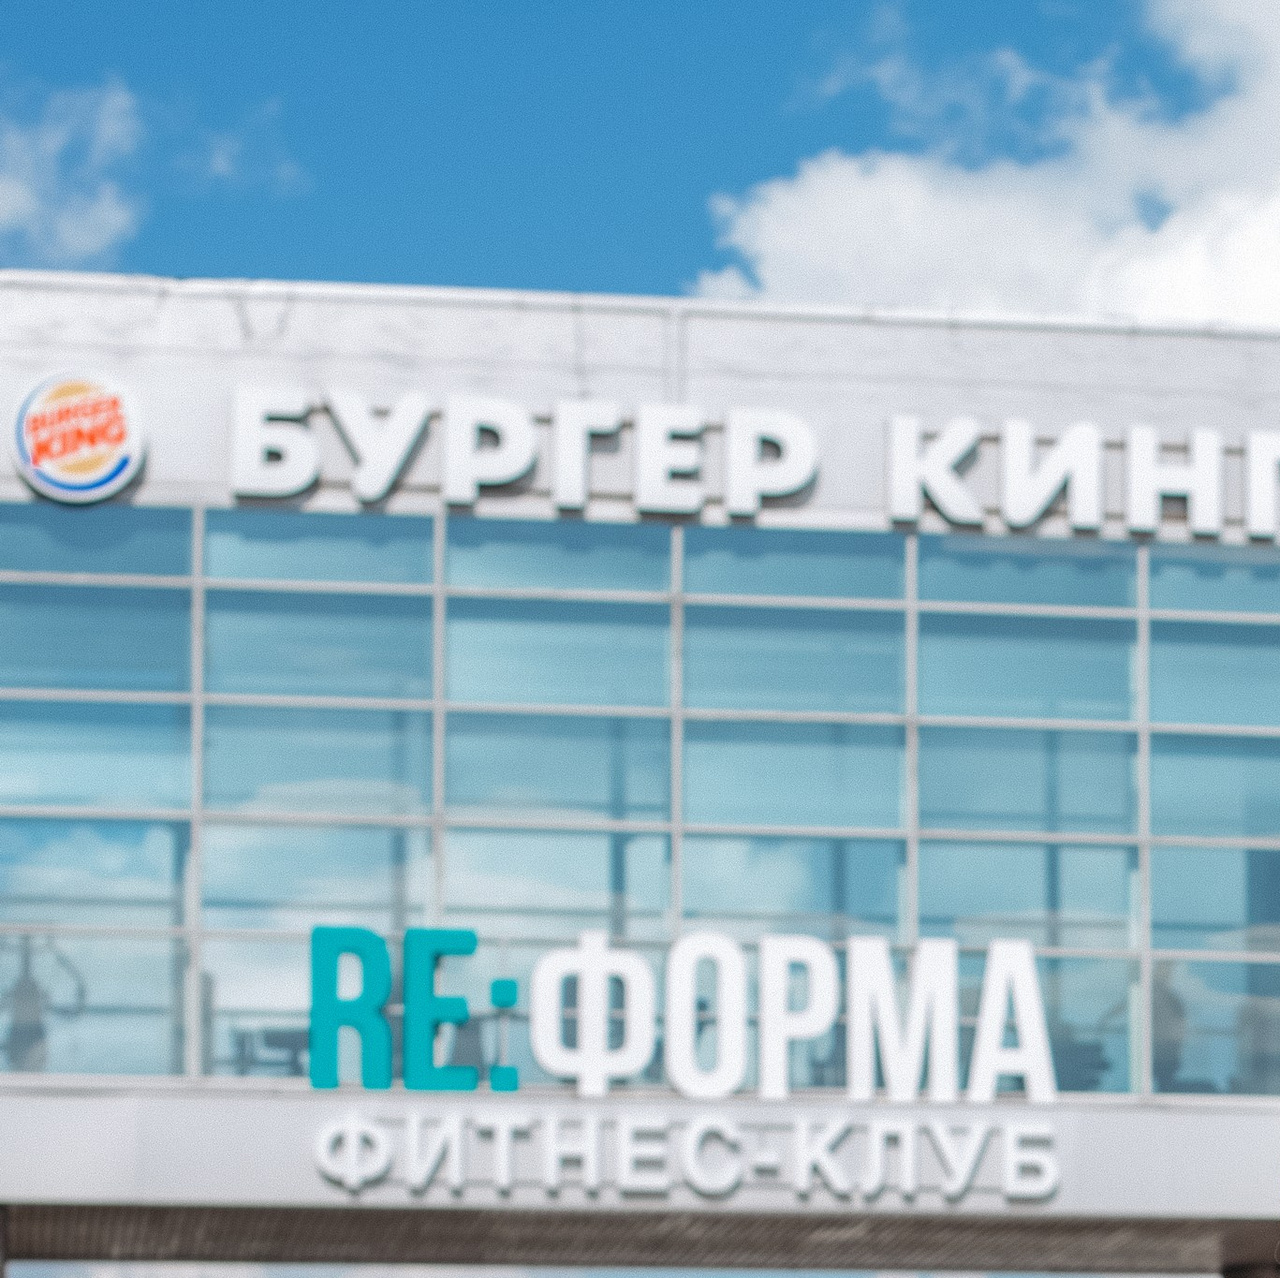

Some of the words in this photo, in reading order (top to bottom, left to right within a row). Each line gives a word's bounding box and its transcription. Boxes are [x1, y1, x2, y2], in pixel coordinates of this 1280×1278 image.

[31, 415, 125, 467] KING
[232, 389, 819, 519] БУРГЕР
[313, 1110, 1061, 1201] ФИТНЕС-КЛУБ
